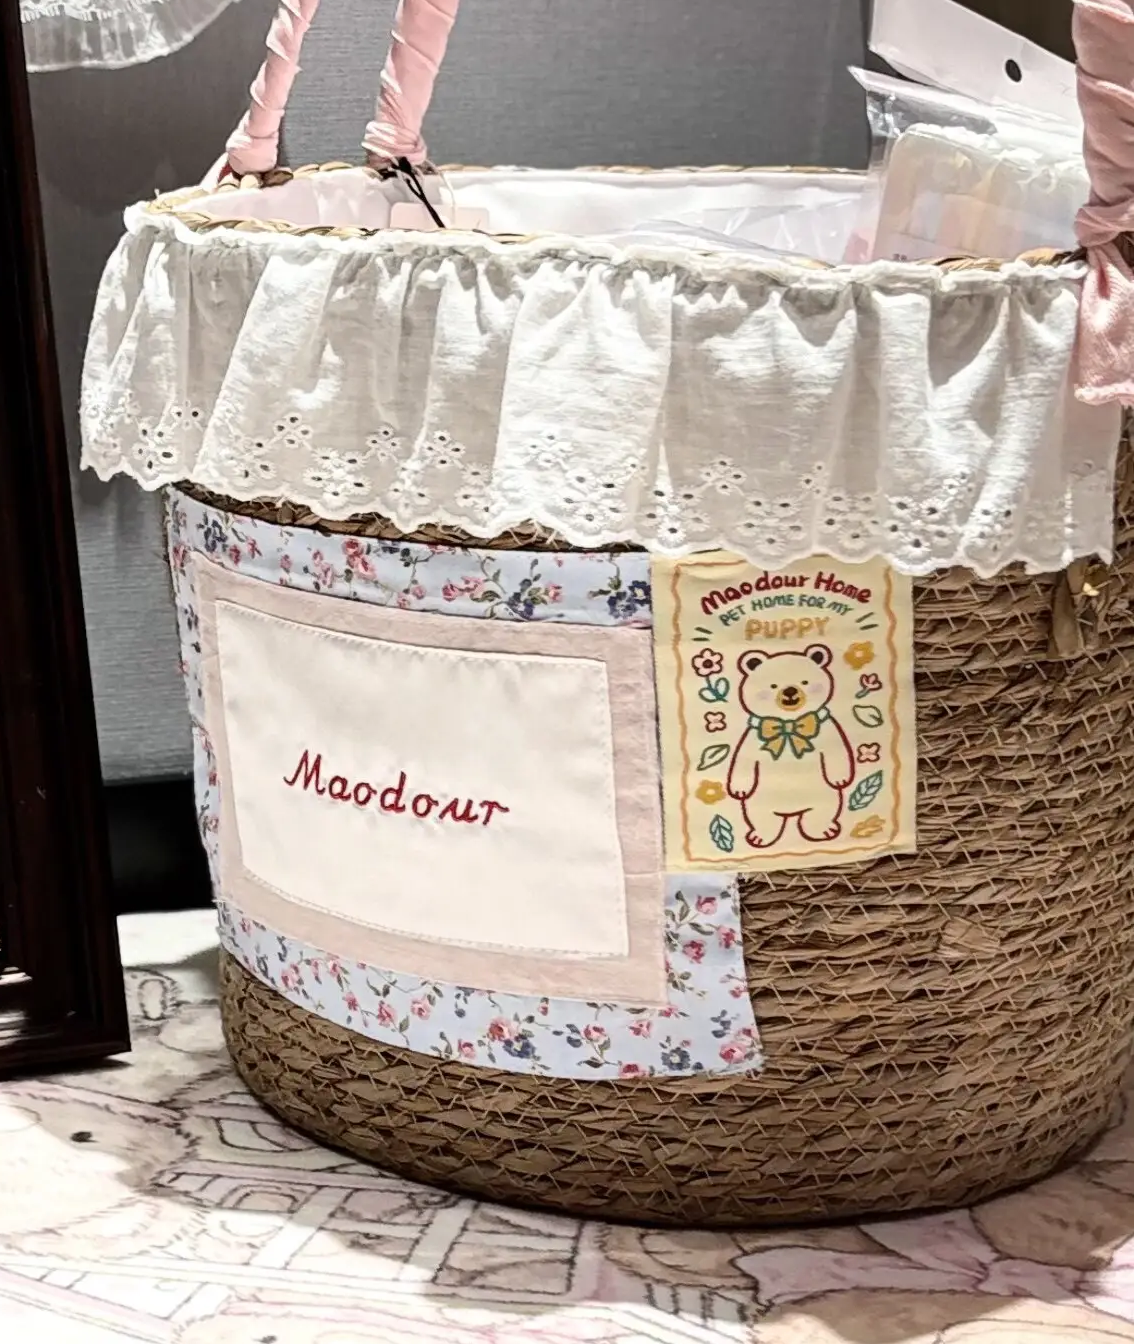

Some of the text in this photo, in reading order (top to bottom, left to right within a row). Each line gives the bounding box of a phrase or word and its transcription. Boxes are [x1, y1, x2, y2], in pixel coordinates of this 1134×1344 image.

[701, 571, 872, 615] Maodour Home
[719, 594, 854, 626] PET HOME FOR MY
[745, 617, 830, 640] PUPPY
[283, 749, 509, 825] Maodour
